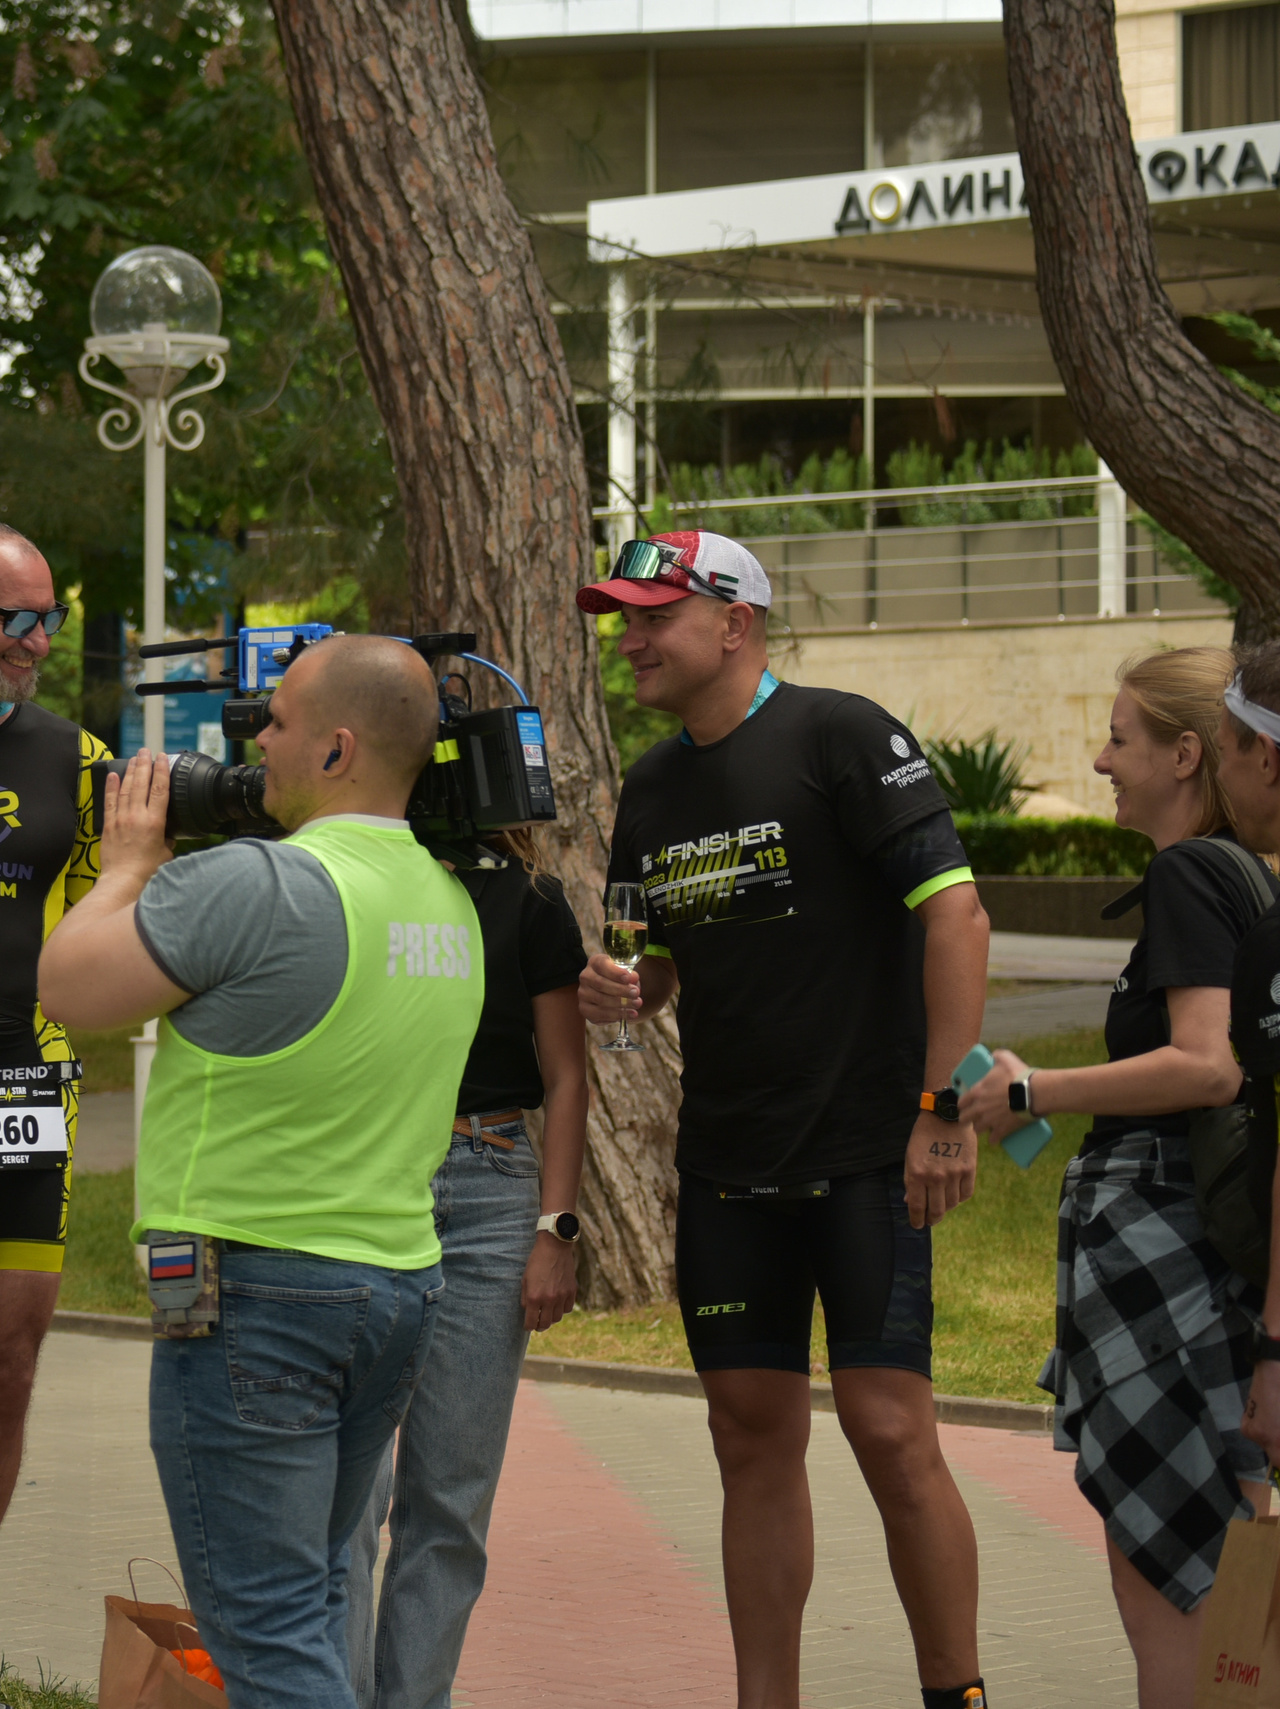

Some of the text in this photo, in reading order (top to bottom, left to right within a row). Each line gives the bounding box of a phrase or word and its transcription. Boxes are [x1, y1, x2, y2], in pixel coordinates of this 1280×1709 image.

[1147, 139, 1280, 193] ФКА
[666, 821, 783, 865] FINISHER
[754, 846, 788, 871] 113
[387, 922, 471, 980] PRESS
[11, 1086, 27, 1096] STAR
[1, 1155, 30, 1164] SERGEY
[928, 1141, 963, 1158] 427
[696, 1301, 747, 1316] ZONE3
